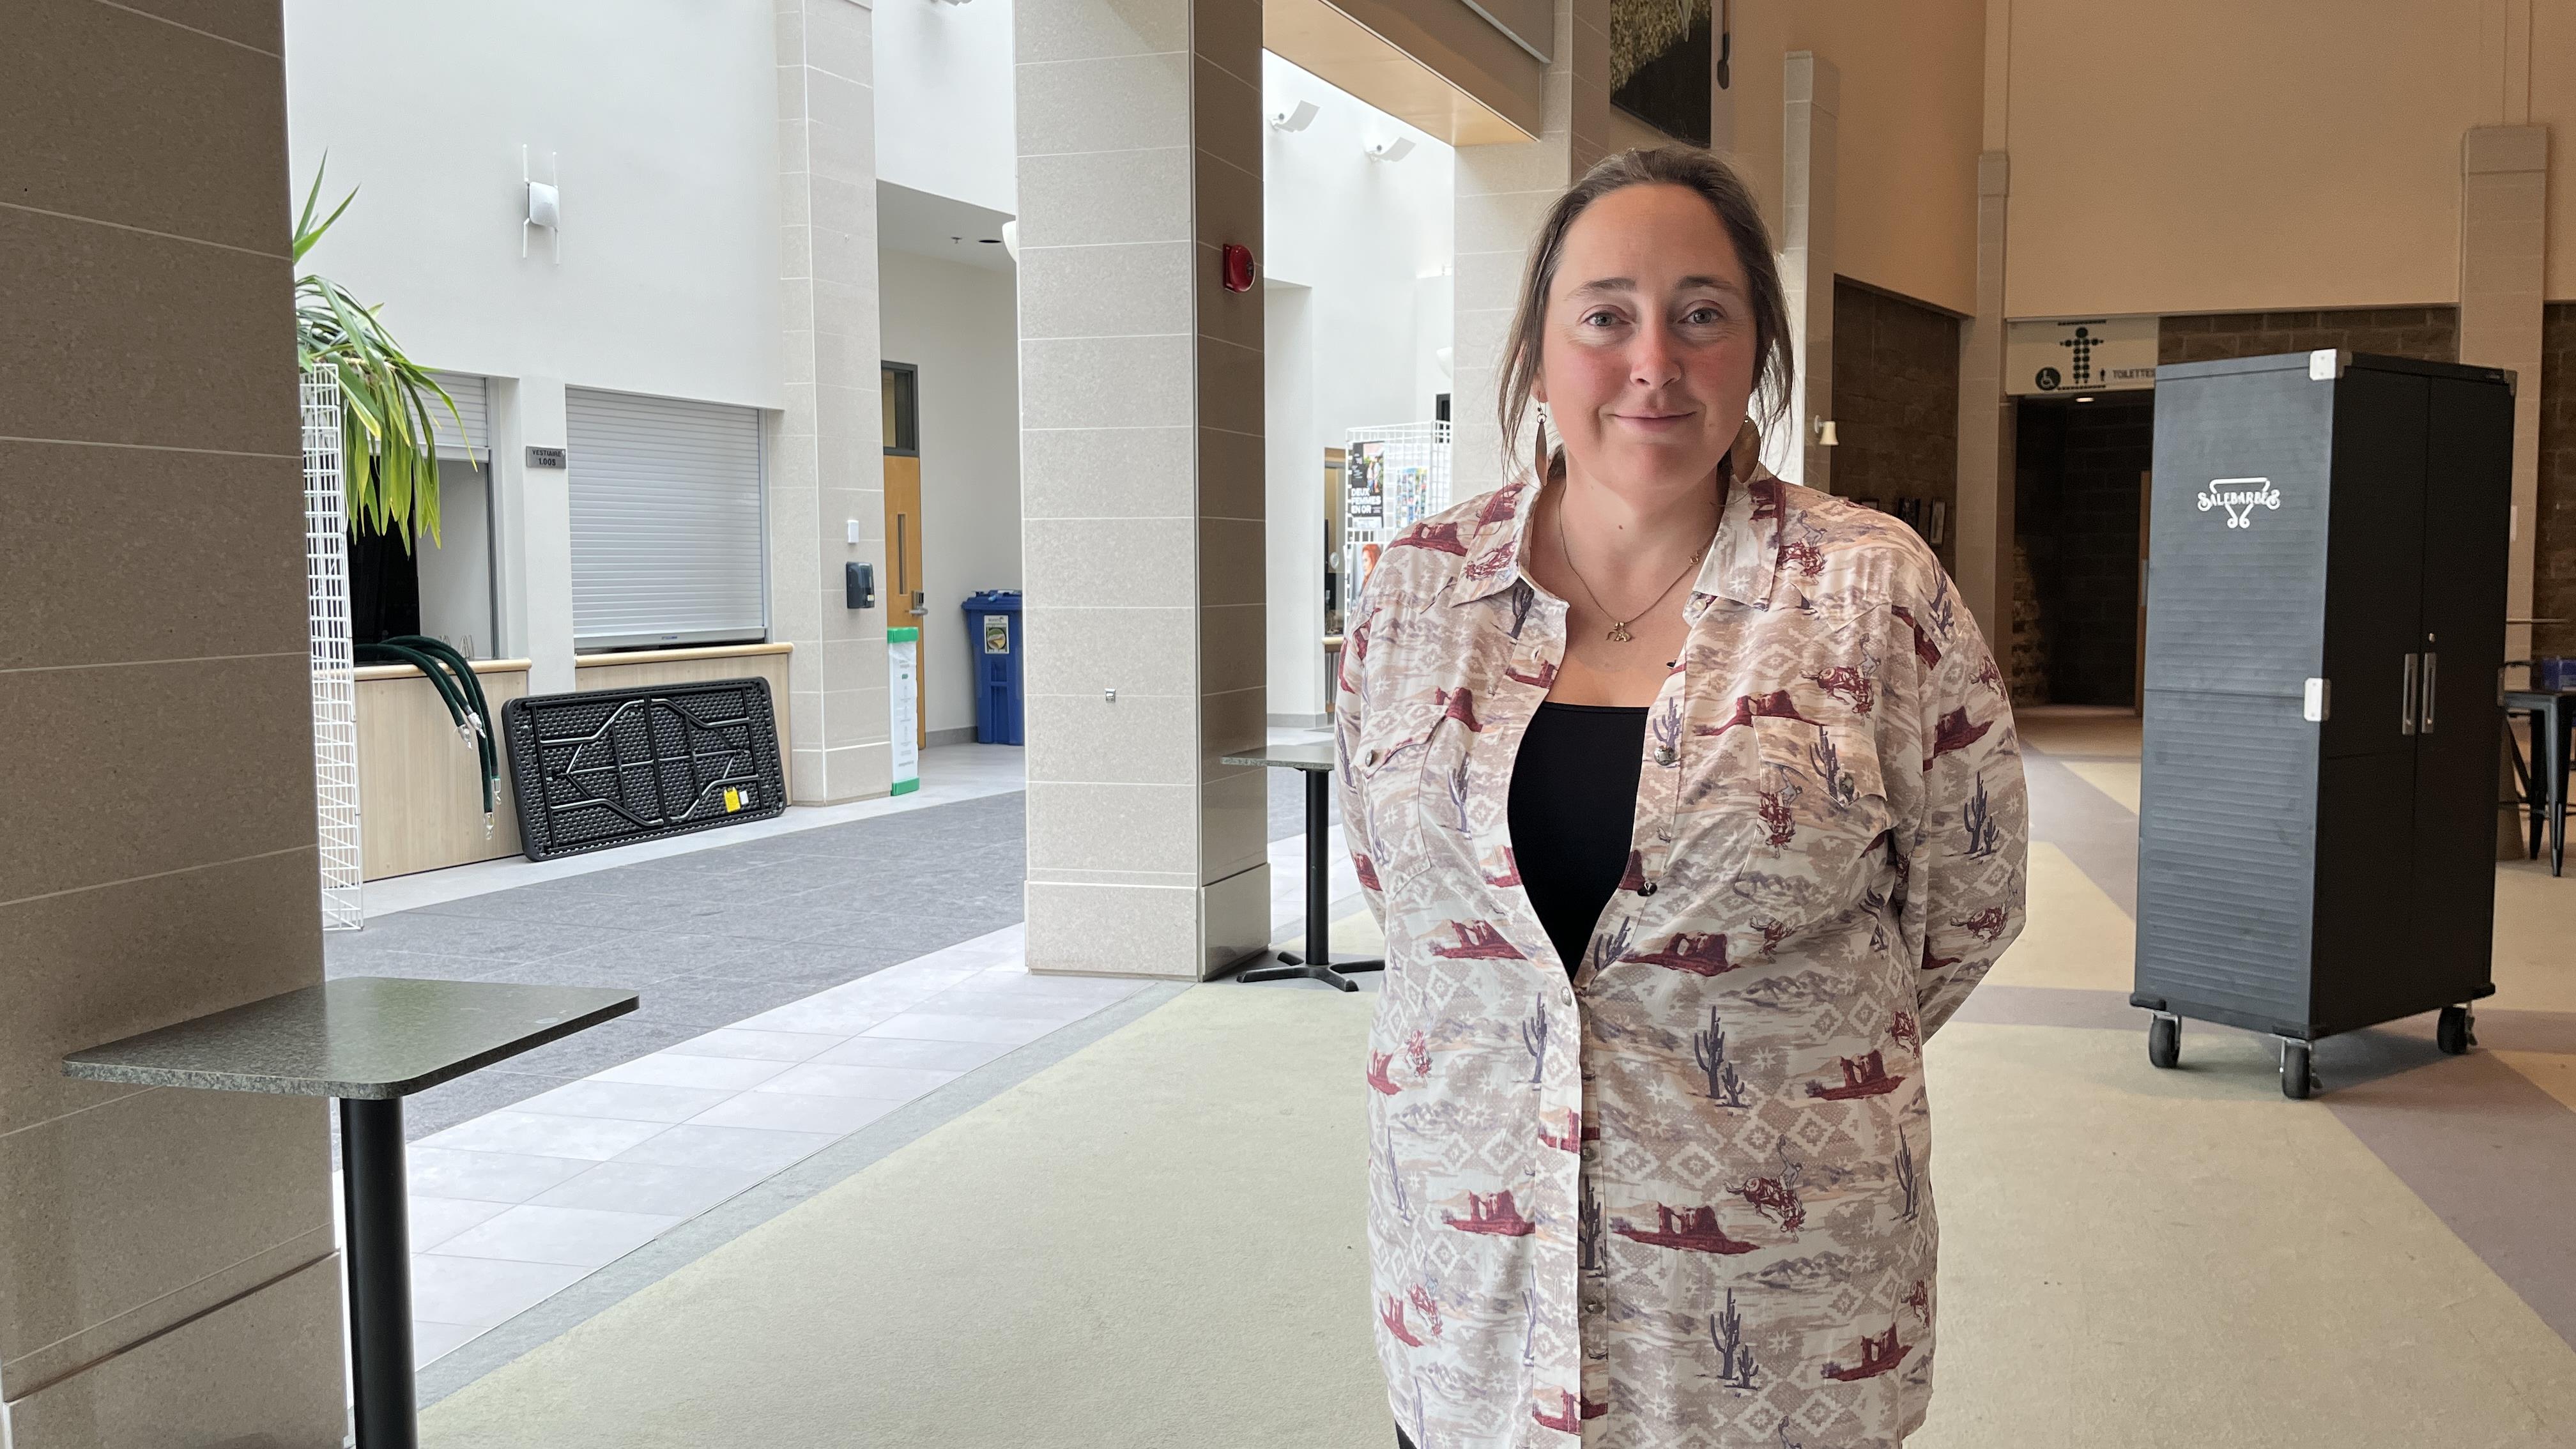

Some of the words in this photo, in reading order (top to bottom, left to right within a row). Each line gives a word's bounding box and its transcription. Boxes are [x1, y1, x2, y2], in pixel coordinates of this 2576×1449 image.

[532, 449, 562, 457] VESTIAIRE
[1351, 488, 1370, 497] DEUX
[1351, 496, 1382, 505] FEMMES
[1351, 505, 1361, 514] EN
[1361, 505, 1372, 514] OR
